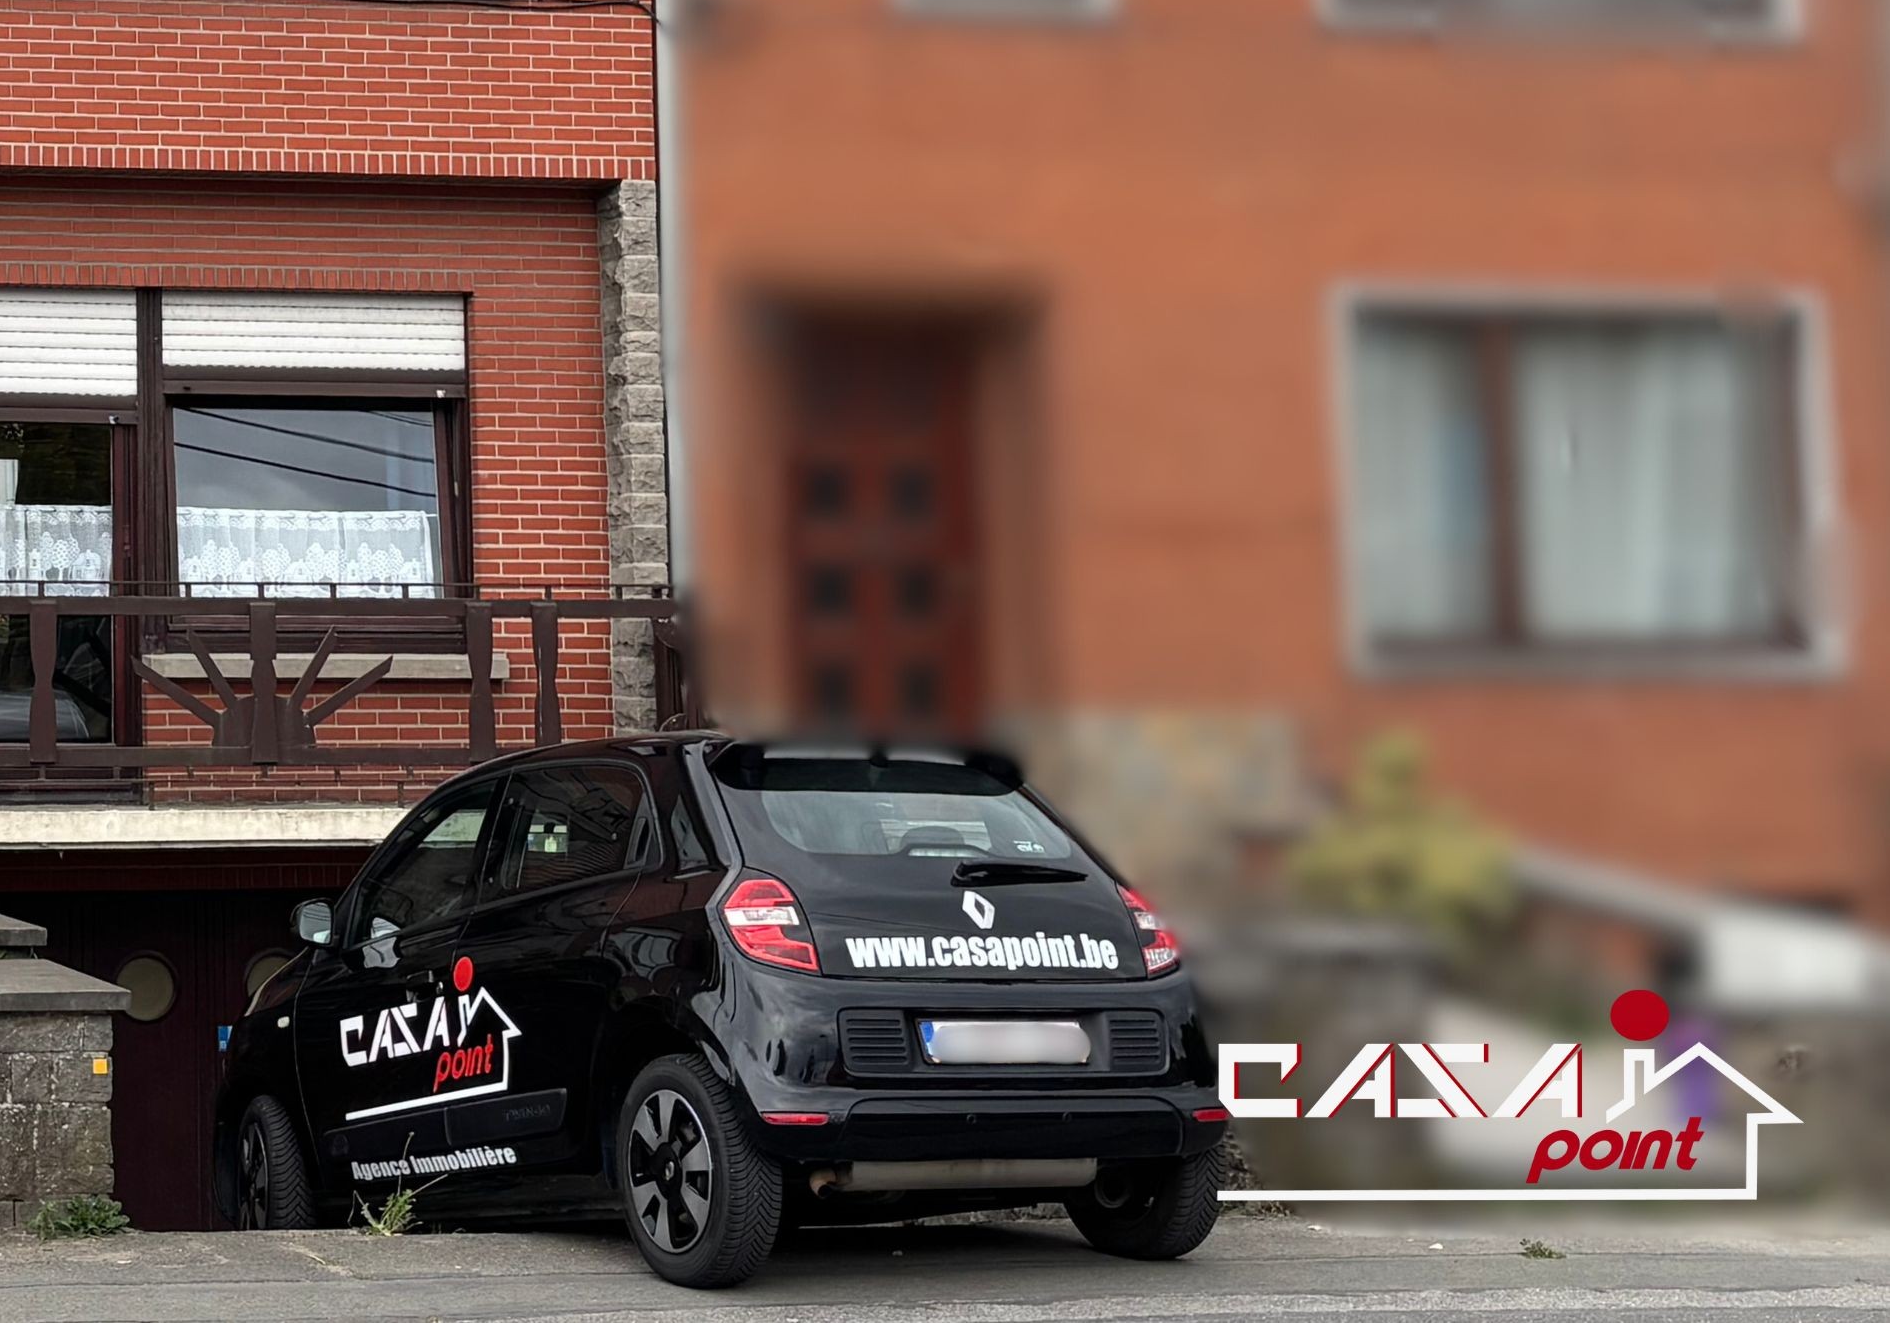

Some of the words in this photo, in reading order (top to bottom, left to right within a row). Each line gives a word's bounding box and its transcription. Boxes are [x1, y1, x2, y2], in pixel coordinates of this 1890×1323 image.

[845, 931, 1119, 971] www.casapoint.be
[339, 996, 450, 1067] CASA
[433, 1033, 494, 1093] point
[351, 1156, 410, 1180] Agence
[410, 1145, 517, 1174] Immobilière
